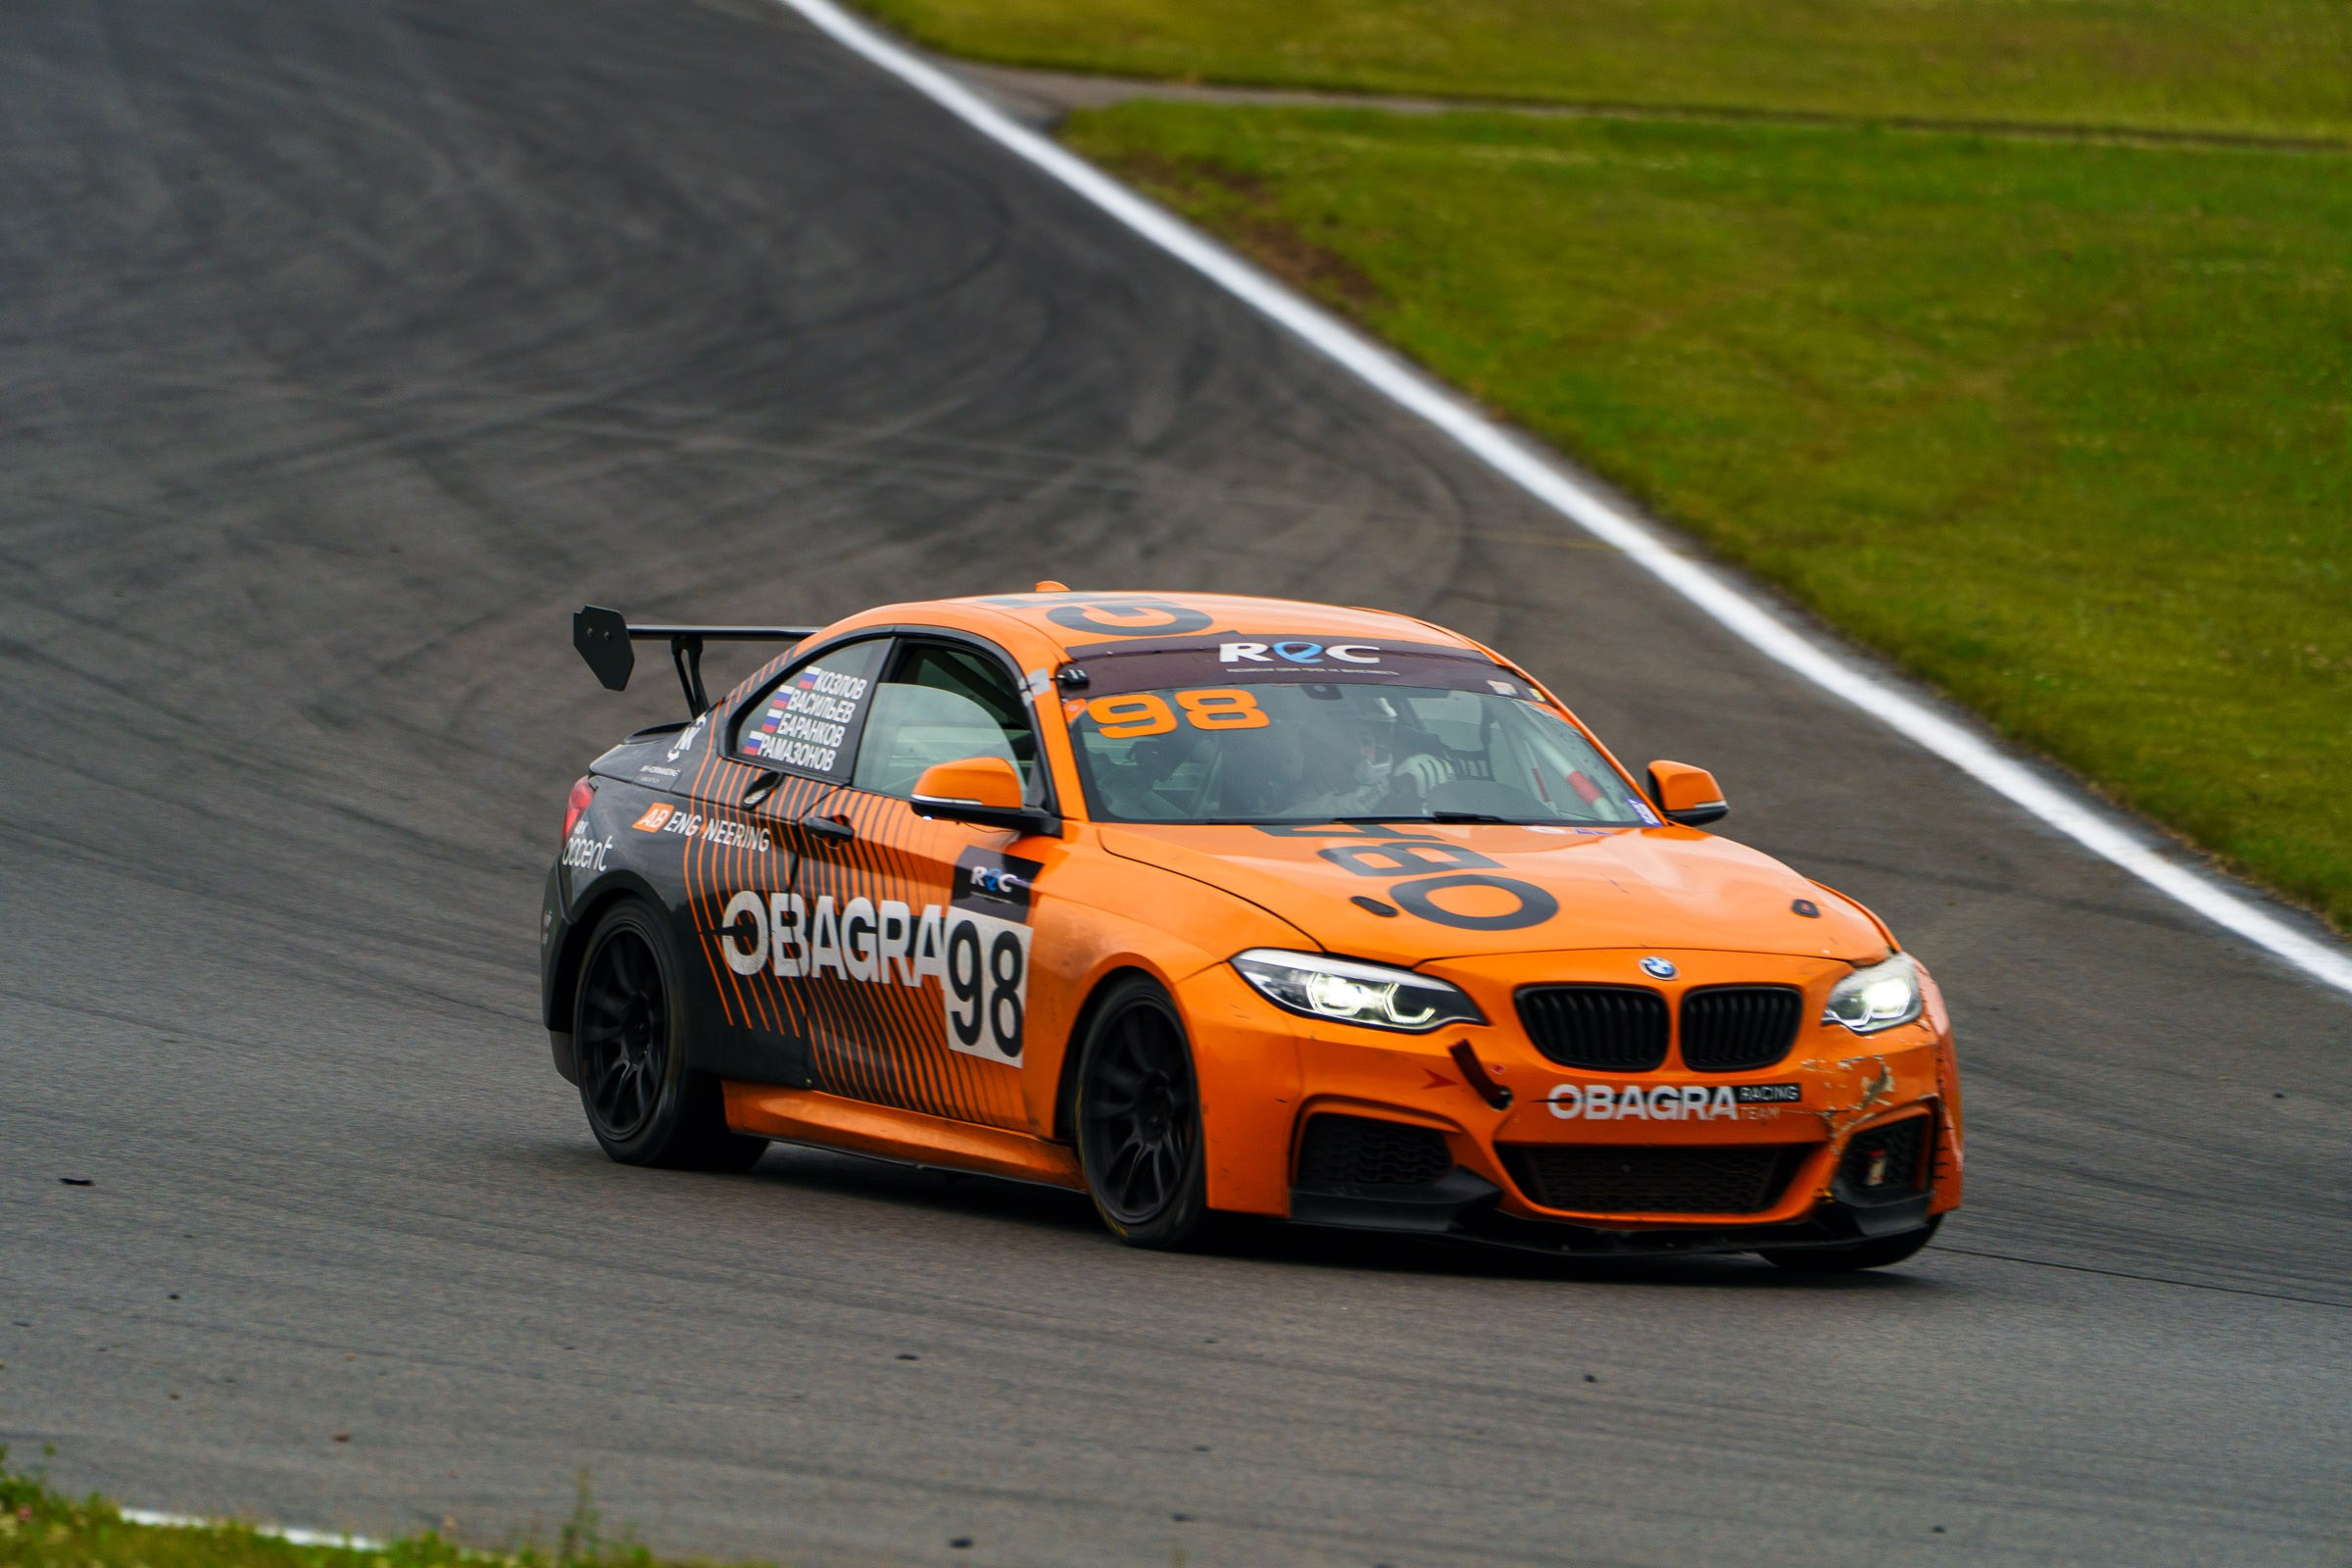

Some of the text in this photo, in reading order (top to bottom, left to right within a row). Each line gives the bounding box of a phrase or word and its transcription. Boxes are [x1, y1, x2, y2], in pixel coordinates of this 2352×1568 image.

[812, 670, 867, 701] КОЗЛОВ
[786, 689, 857, 724] ВАСИЛЬЕВ
[1087, 689, 1270, 739] 98
[776, 712, 846, 748] БАРАНКОВ
[757, 735, 837, 771] РАМАЗОНОВ
[638, 808, 669, 829] AB
[721, 890, 945, 988] OBAGRA
[948, 920, 1024, 1057] 98
[1547, 1084, 1799, 1121] OBAGRA RACING
